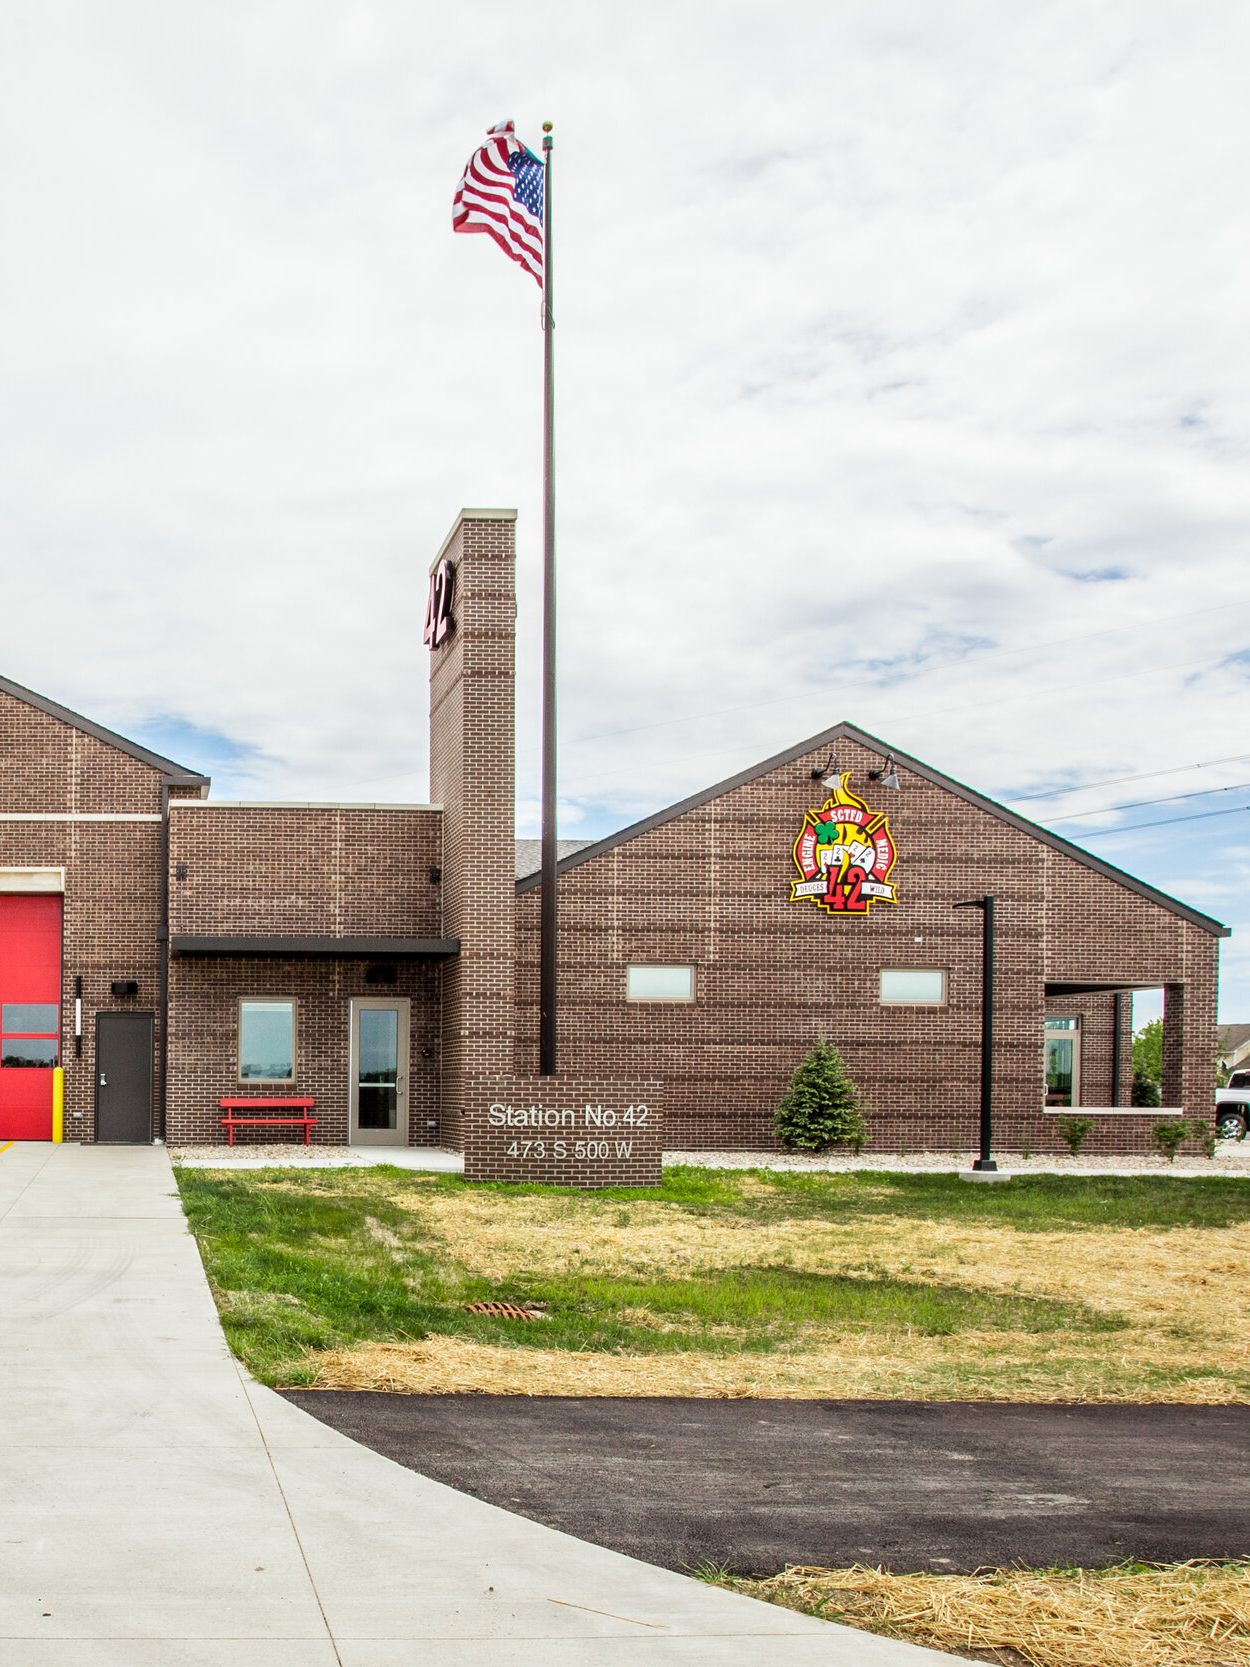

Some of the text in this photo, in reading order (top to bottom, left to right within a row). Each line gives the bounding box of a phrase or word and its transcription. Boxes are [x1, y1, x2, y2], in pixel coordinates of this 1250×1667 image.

[423, 559, 453, 651] 42
[830, 809, 863, 823] SCTFD
[803, 833, 816, 872] ENGINE
[875, 838, 890, 871] MEDIC
[800, 883, 885, 894] DEUCES WILD
[824, 866, 866, 909] 42
[489, 1104, 648, 1127] Station No.42
[507, 1141, 633, 1159] 473 S 500 W
